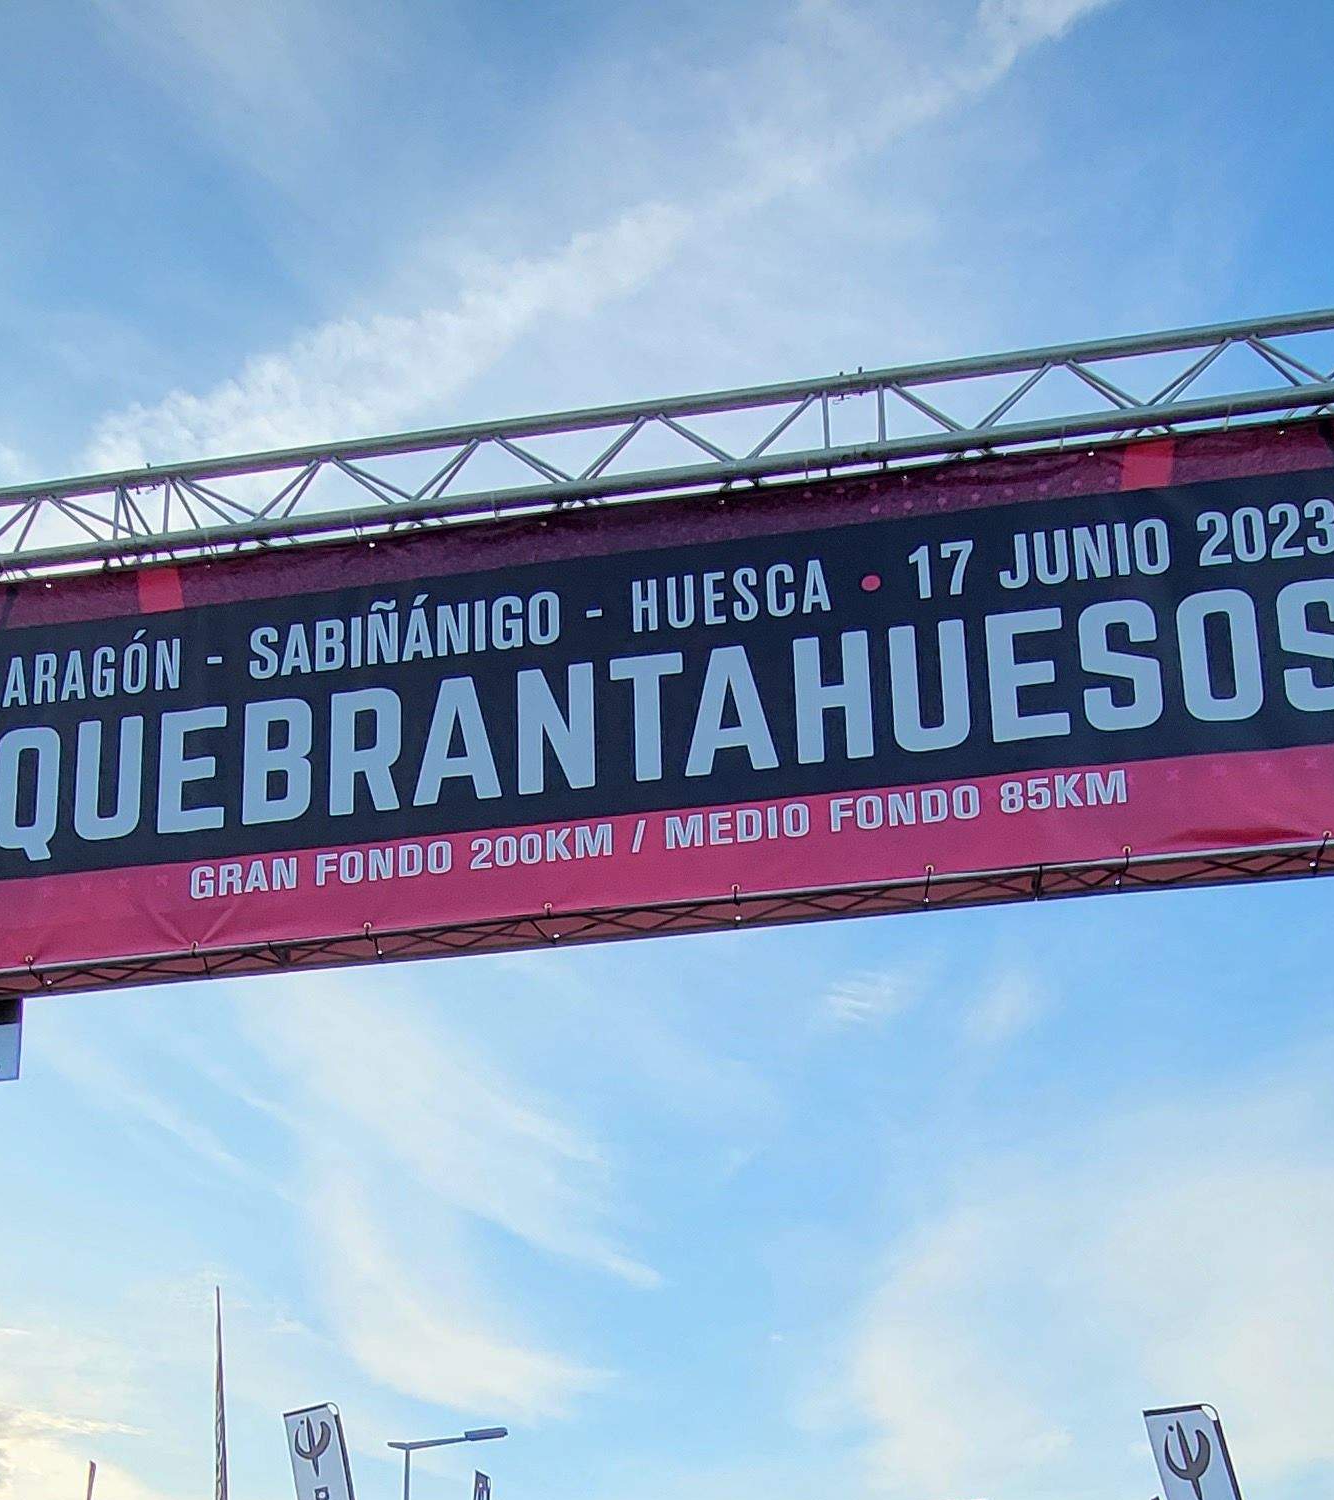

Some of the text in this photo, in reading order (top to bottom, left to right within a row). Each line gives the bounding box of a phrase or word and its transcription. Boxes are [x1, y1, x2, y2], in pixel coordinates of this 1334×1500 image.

[2, 629, 181, 708] ARAGÓN
[248, 590, 560, 681] SABIÑÁNIGO
[630, 558, 831, 634] HUESCA
[908, 539, 974, 600] 17
[998, 516, 1170, 589] JUNIO
[190, 856, 298, 900] GRAN
[314, 838, 454, 888] FONDO
[470, 823, 613, 870] 200KM
[665, 803, 810, 851] MEDIO
[830, 784, 982, 833] FONDO
[999, 770, 1128, 815] 85KM
